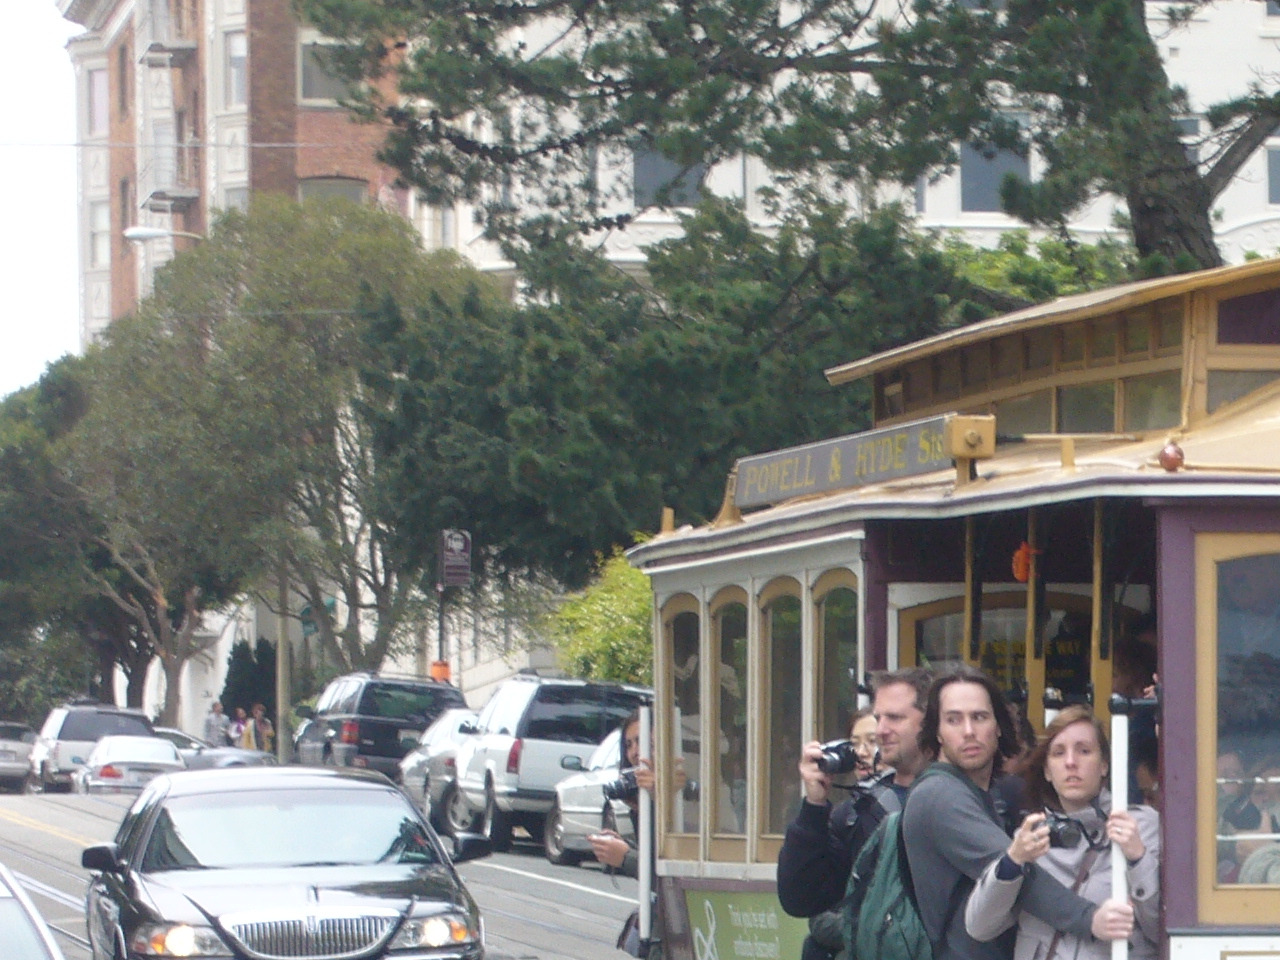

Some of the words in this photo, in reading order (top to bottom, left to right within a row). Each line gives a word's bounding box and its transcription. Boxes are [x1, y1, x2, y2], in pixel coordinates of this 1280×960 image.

[744, 455, 817, 498] POWELL
[829, 446, 842, 482] &
[855, 433, 908, 476] HYDE
